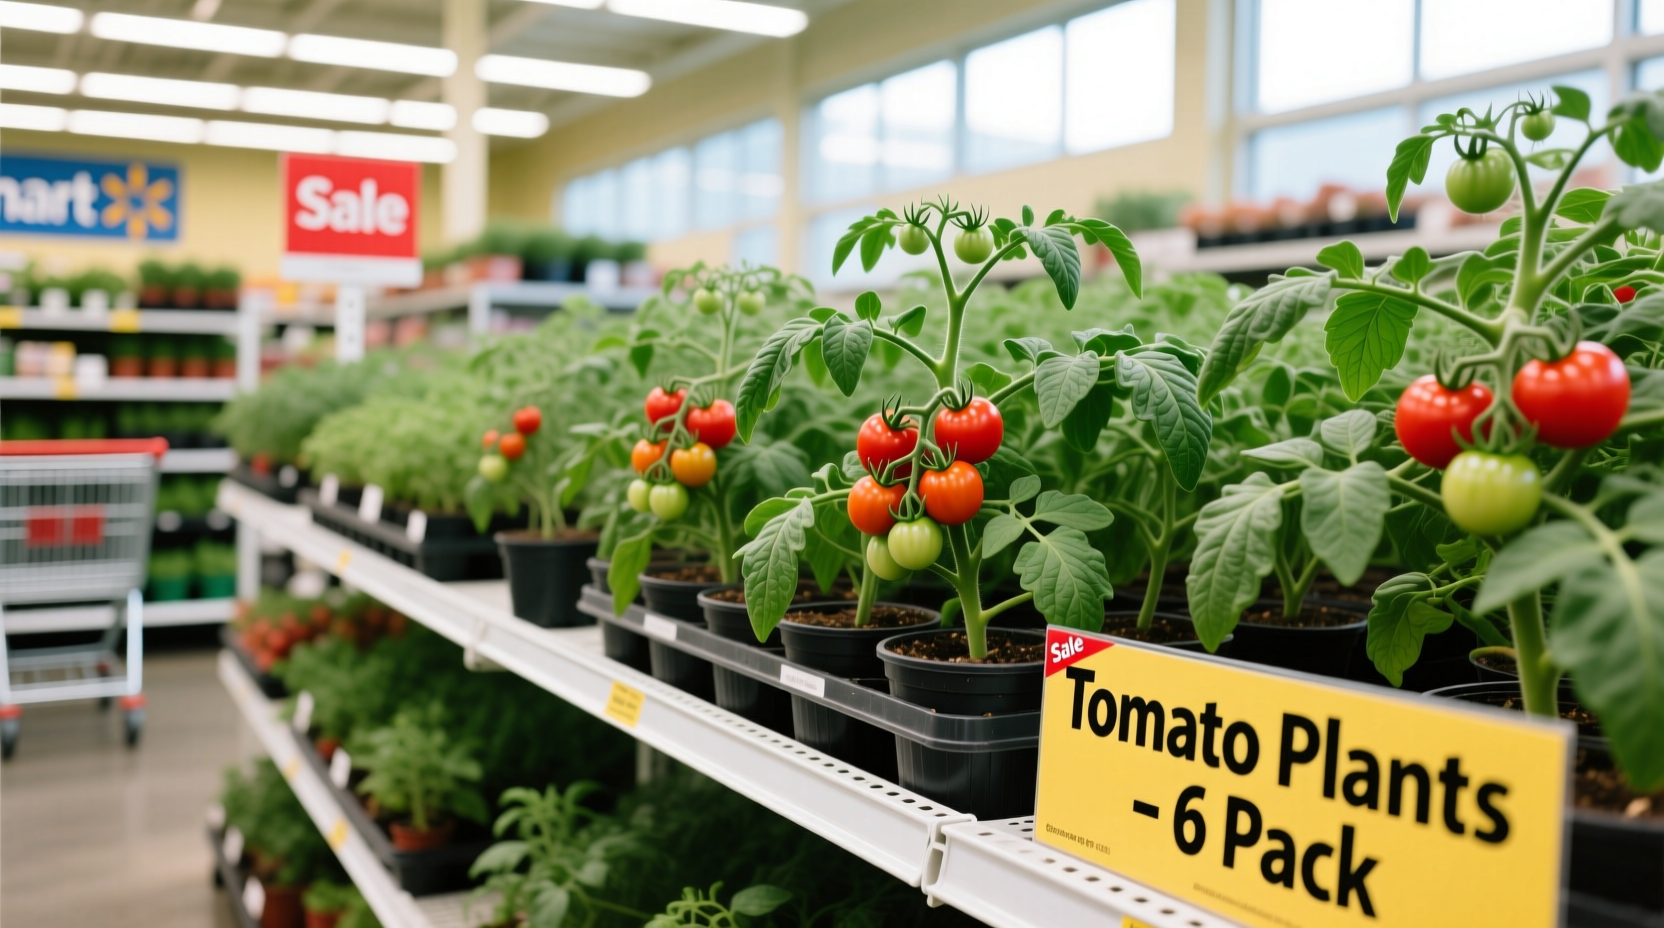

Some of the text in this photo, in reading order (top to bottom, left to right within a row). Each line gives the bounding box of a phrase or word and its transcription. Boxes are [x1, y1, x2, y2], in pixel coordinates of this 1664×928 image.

[294, 175, 410, 237] Sale
[1051, 636, 1084, 663] Sale
[1066, 666, 1510, 844] Tomato Plants
[1173, 785, 1206, 855] 6
[1223, 795, 1379, 919] Pack
